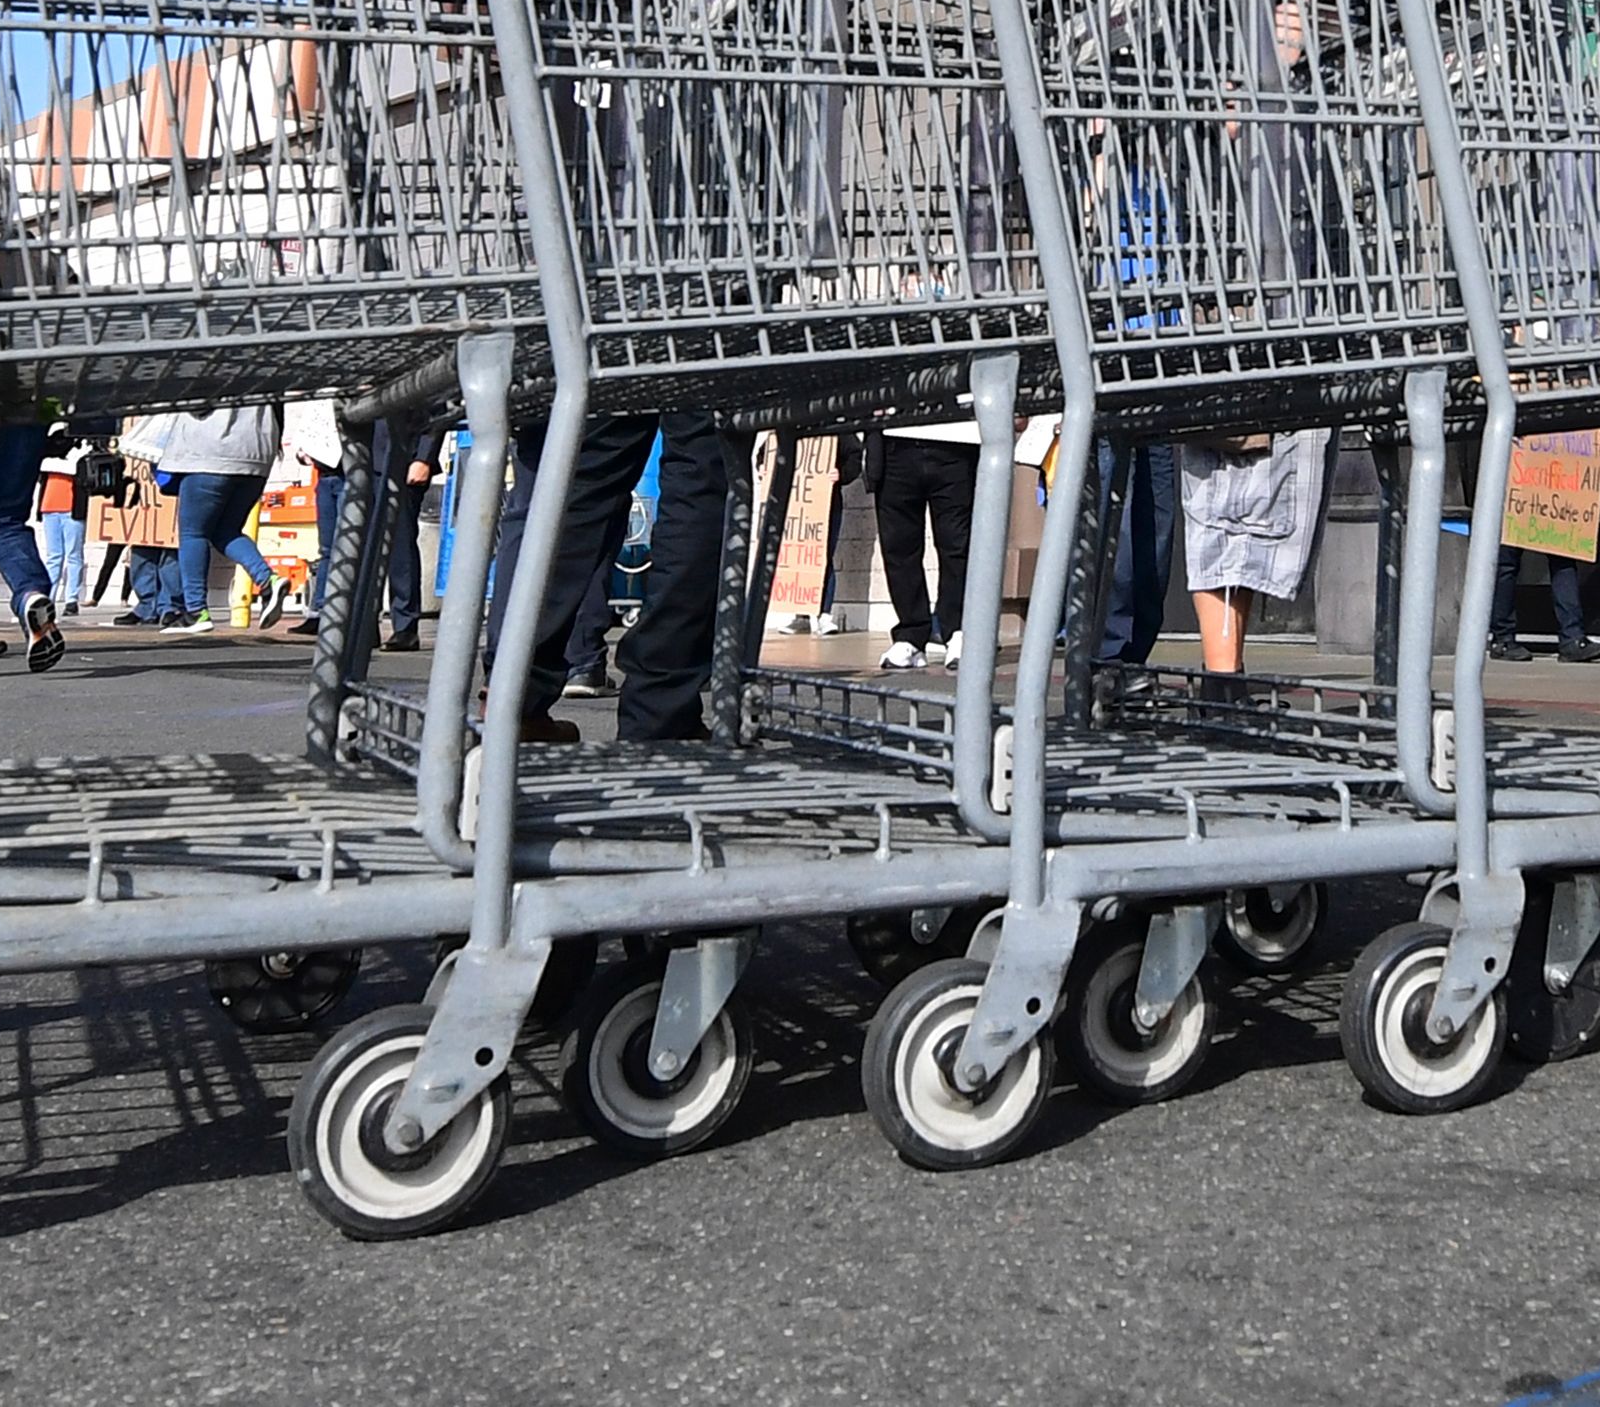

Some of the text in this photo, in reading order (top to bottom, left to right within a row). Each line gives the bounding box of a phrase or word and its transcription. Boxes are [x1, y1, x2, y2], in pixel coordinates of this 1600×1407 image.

[1580, 465, 1600, 492] All
[98, 497, 179, 546] EVIL!
[1508, 487, 1598, 523] For the Sake of
